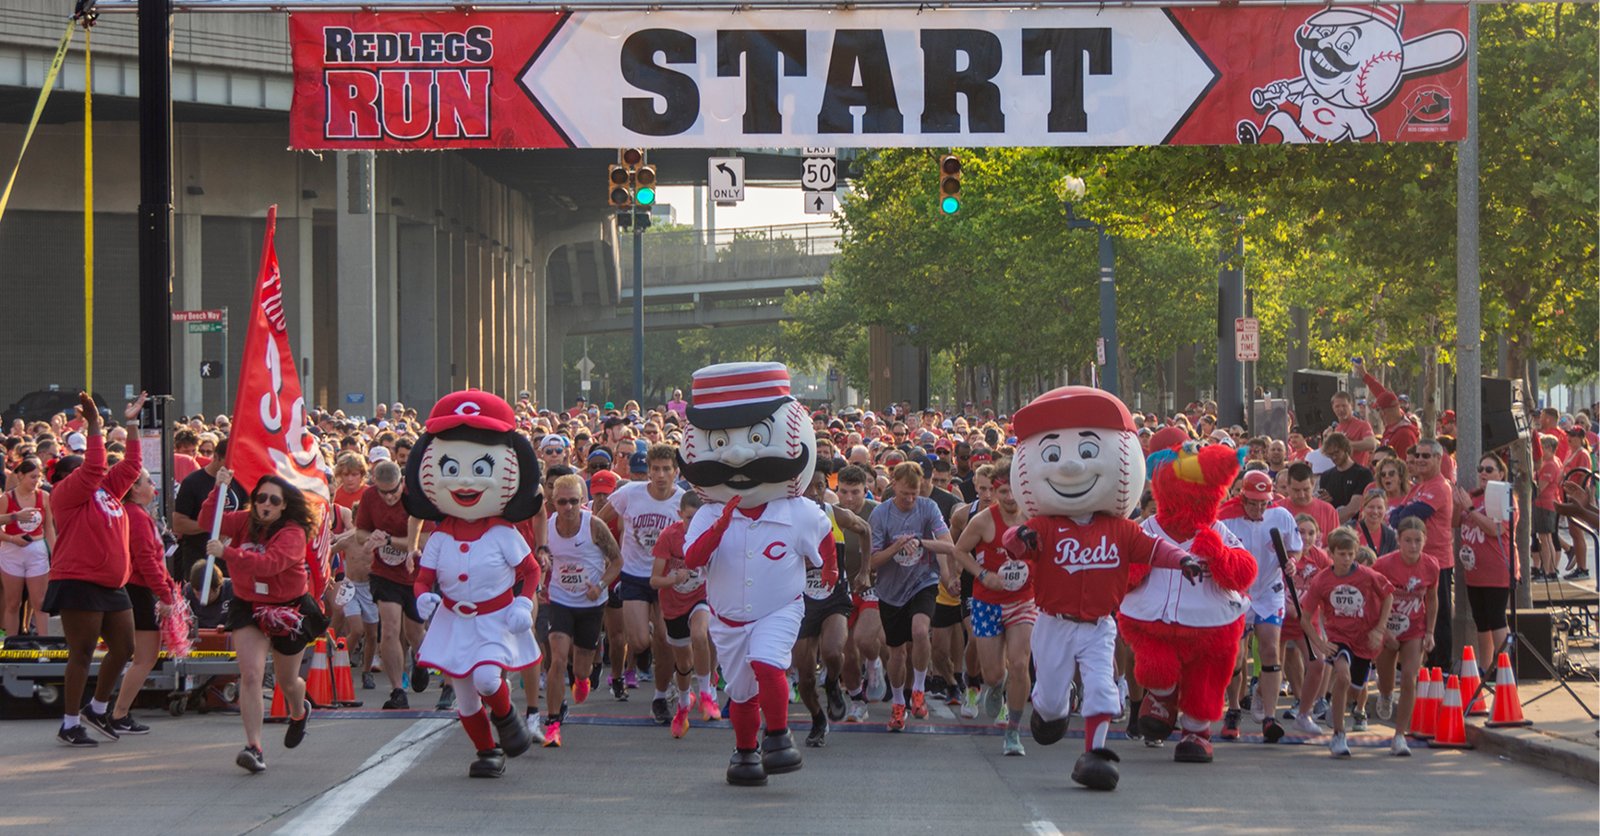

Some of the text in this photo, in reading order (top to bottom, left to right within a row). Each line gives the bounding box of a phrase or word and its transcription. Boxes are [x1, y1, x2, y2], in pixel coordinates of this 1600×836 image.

[323, 25, 493, 64] REDLEGS
[620, 27, 1113, 137] START
[323, 67, 493, 140] RUN
[807, 164, 831, 183] 50
[714, 189, 741, 198] ONLY
[207, 311, 220, 320] Way
[1241, 343, 1255, 351] TIME
[382, 544, 401, 556] 1029
[1054, 535, 1120, 573] Reds
[561, 574, 583, 584] 2251
[1004, 571, 1021, 581] 168
[1335, 596, 1354, 605] 876
